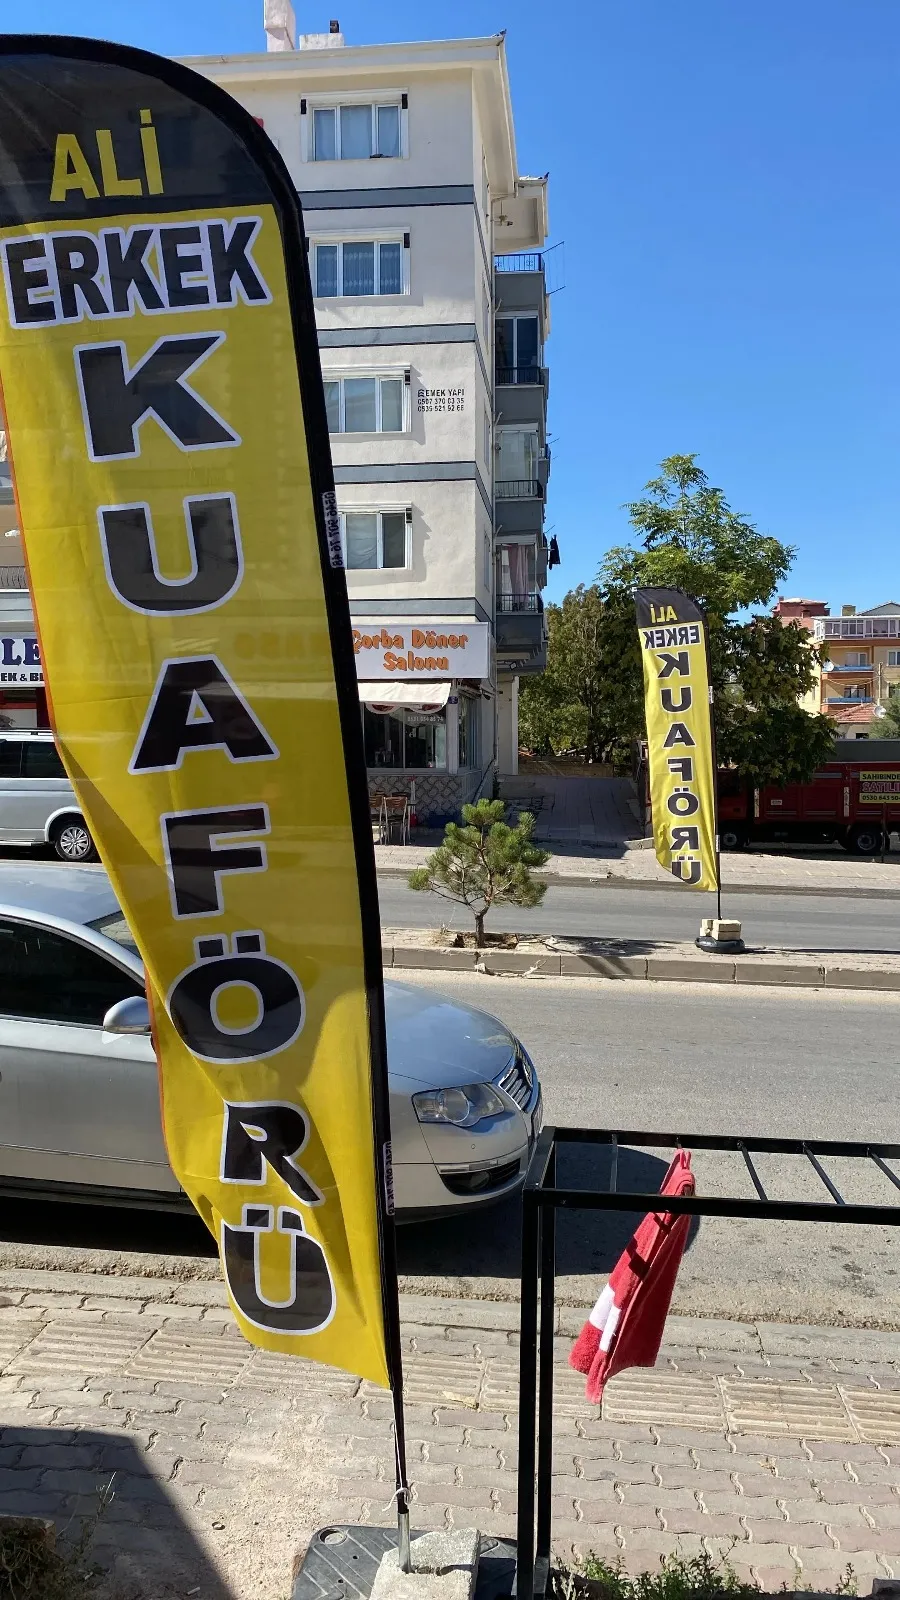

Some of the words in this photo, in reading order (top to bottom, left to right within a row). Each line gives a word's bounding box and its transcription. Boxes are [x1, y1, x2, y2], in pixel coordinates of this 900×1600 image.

[50, 109, 164, 202] ALİ
[2, 217, 273, 328] ERKEK
[411, 629, 469, 649] Döner
[383, 651, 449, 672] Salonu
[19, 673, 27, 681] &
[862, 782, 900, 792] SATILI
[74, 331, 336, 1336] KUAFÖRÜ
